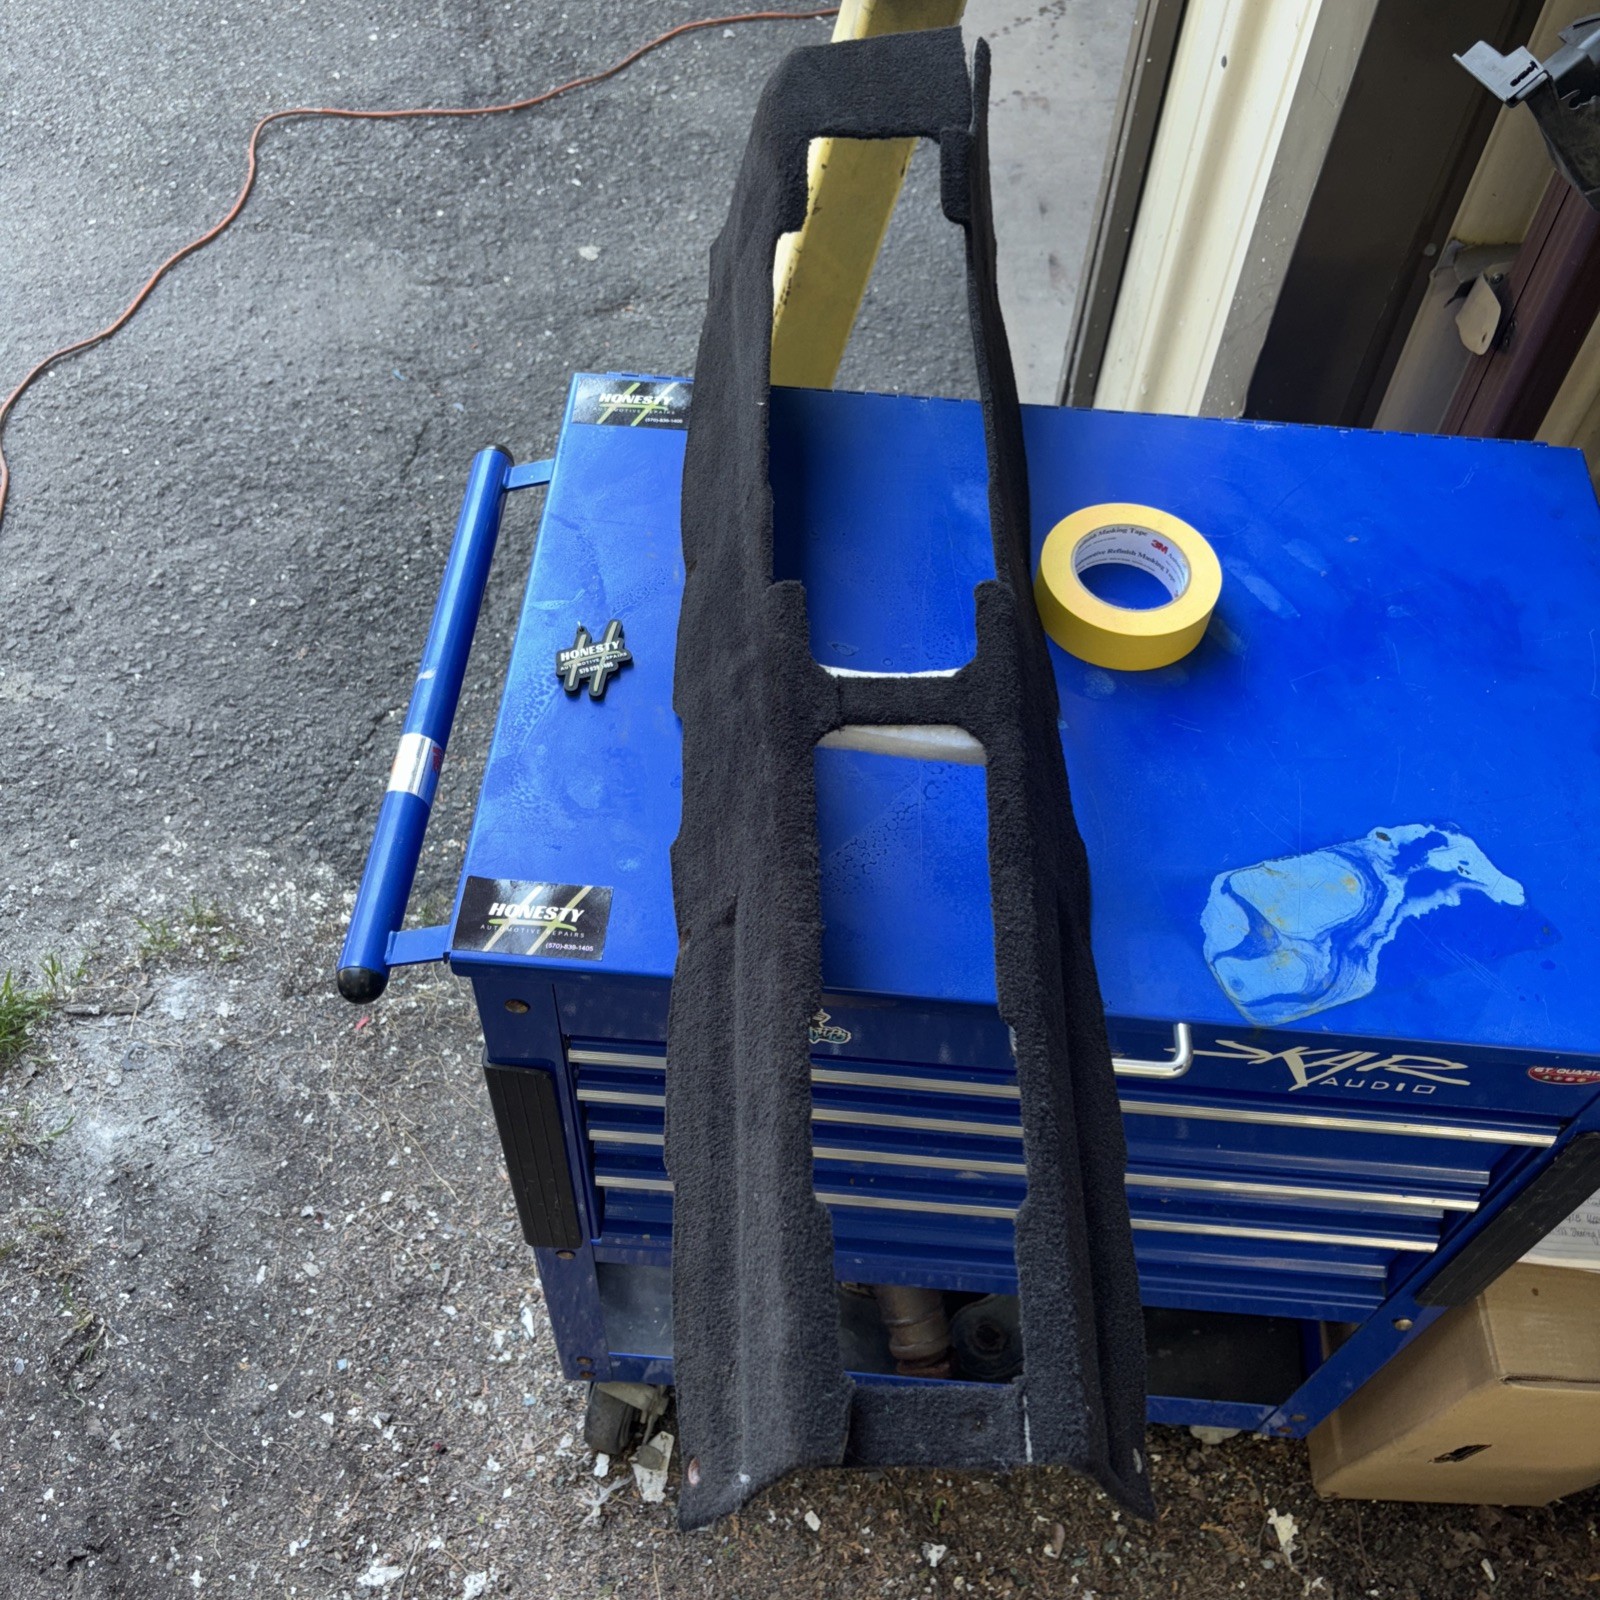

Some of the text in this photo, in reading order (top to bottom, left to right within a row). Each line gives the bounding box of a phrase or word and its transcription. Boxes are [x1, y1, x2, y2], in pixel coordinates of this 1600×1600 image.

[598, 393, 673, 405] HONESTY
[1130, 527, 1148, 536] Tape
[1151, 539, 1169, 555] 3M
[560, 640, 620, 662] HONESTY
[560, 658, 600, 671] AUTMOTIVE
[488, 902, 586, 923] HONESTY
[1319, 1077, 1437, 1095] AUDIO
